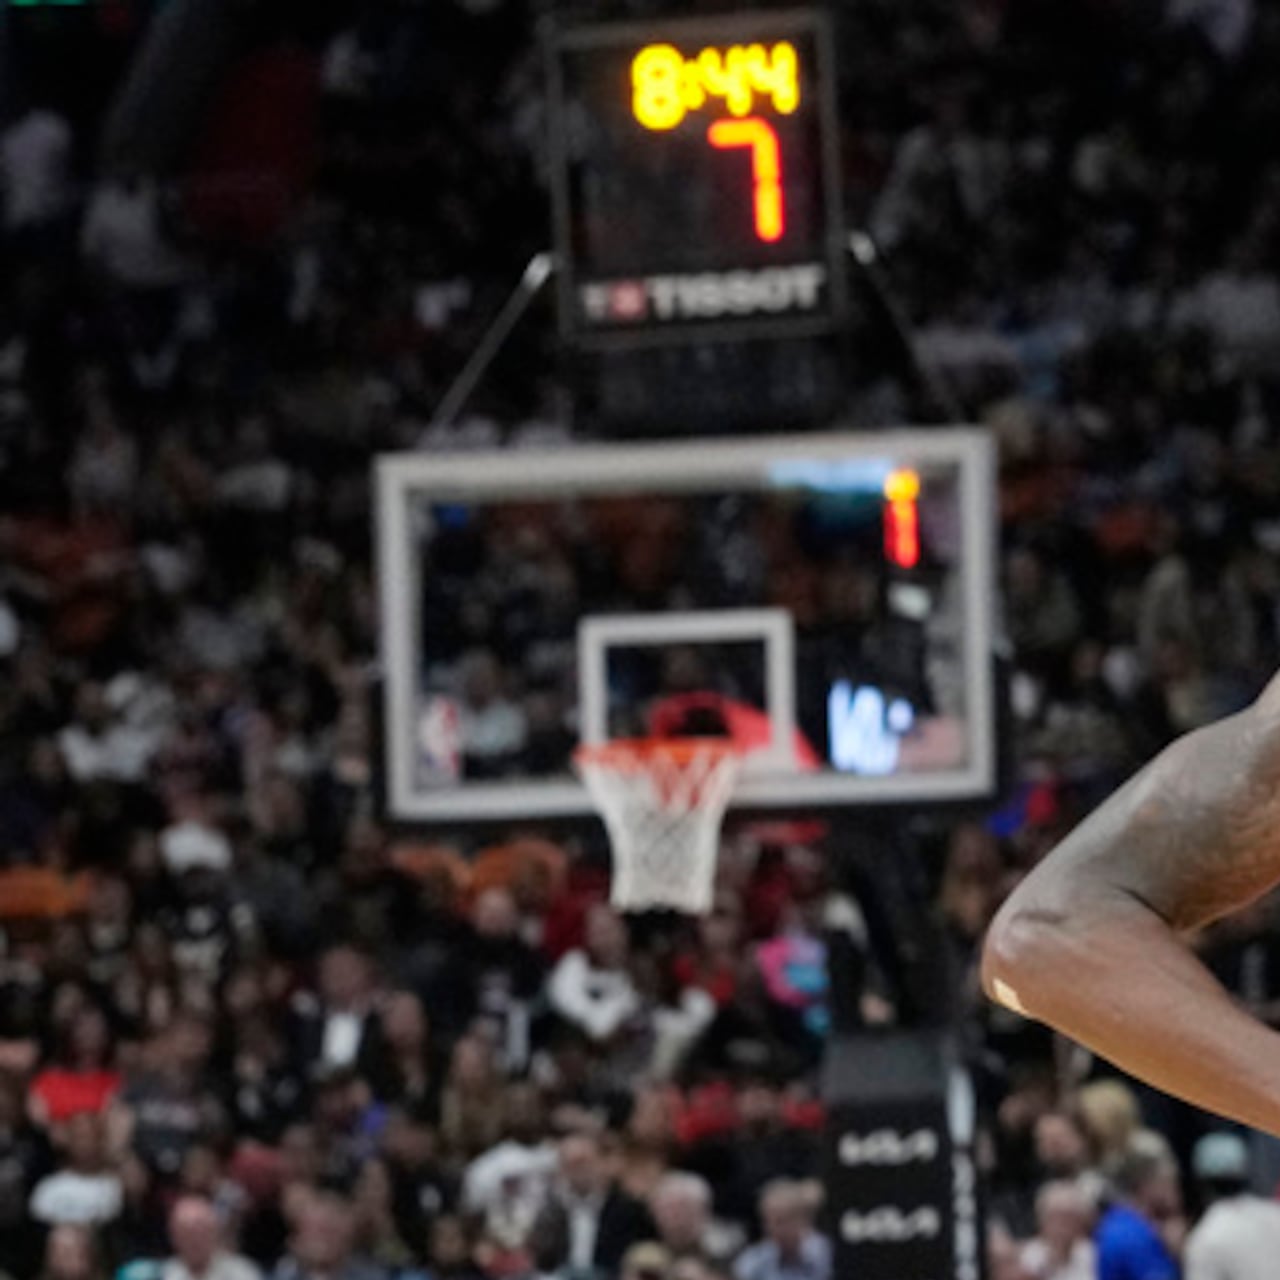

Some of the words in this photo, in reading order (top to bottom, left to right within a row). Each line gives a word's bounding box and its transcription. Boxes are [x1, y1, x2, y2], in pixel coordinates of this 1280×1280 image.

[631, 41, 798, 130] 8:44
[707, 117, 785, 241] 7
[645, 263, 824, 319] TISSOT
